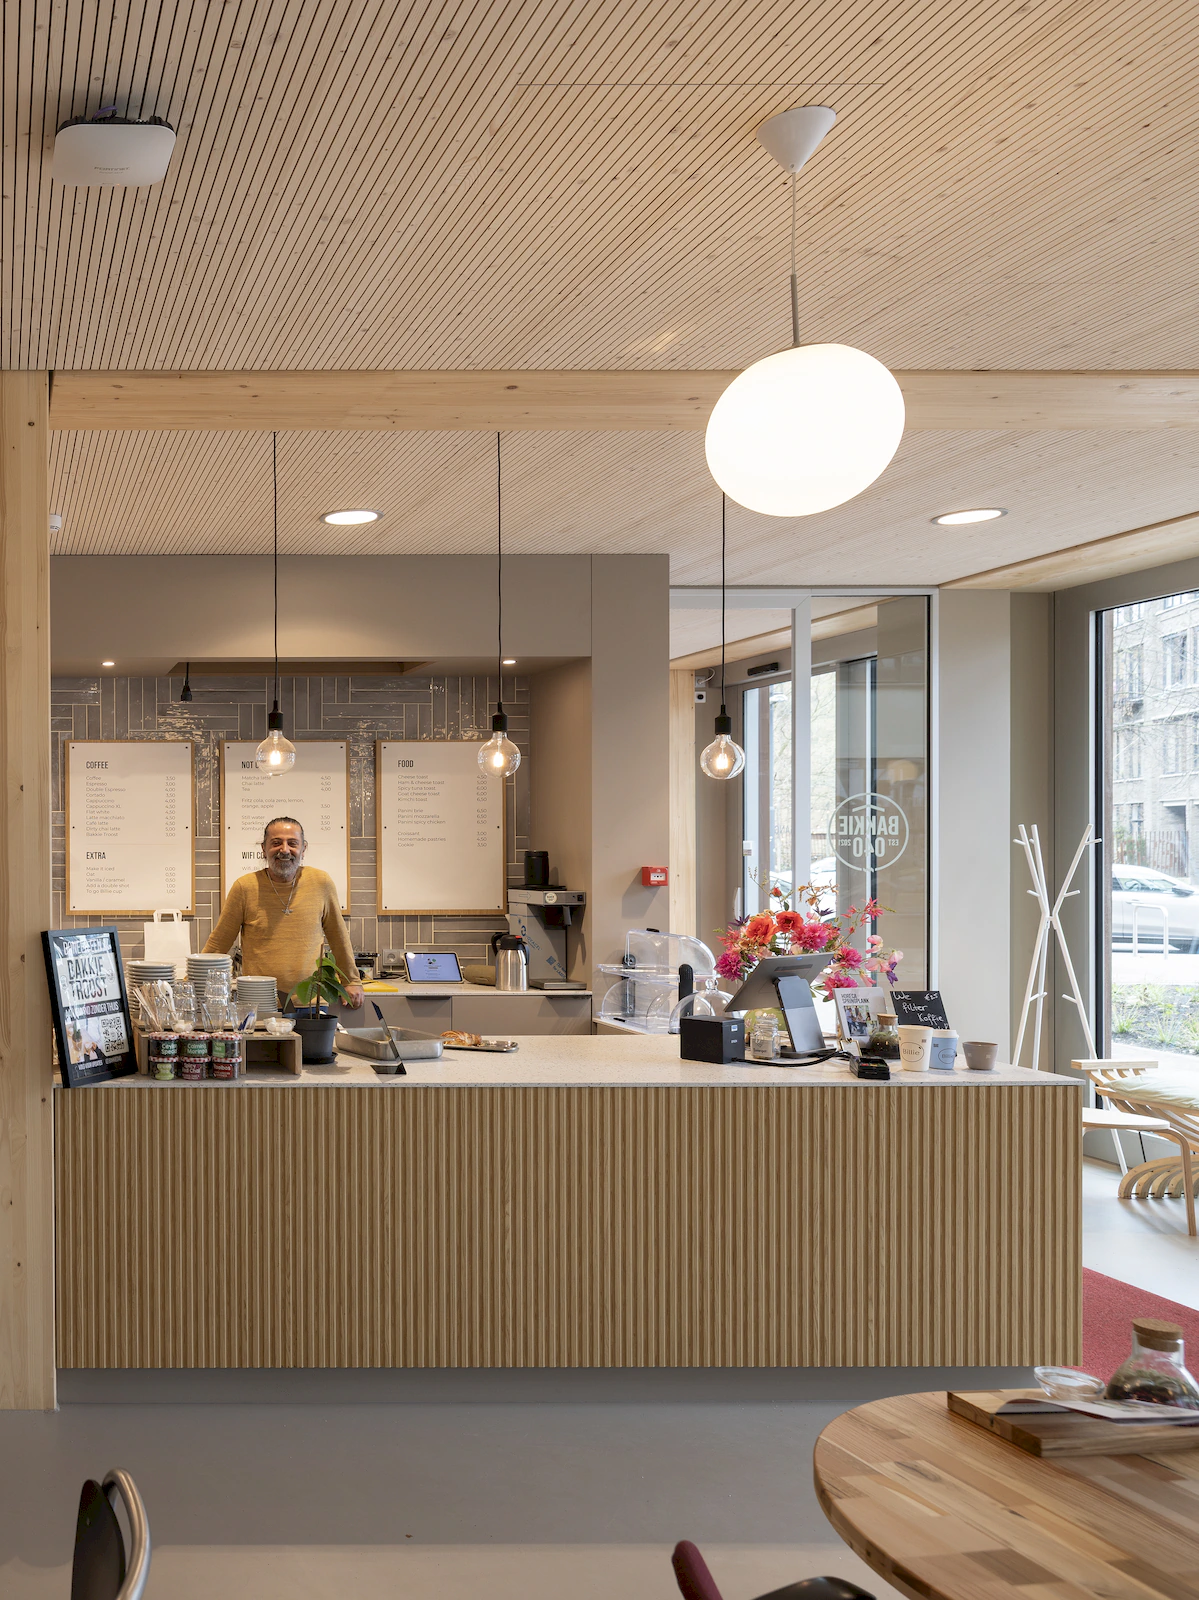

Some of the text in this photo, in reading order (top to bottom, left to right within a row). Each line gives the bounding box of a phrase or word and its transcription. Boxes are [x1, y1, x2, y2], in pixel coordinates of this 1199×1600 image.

[86, 761, 109, 769] COFFEE
[241, 761, 254, 769] NOT
[398, 760, 414, 768] FOOD
[241, 851, 255, 859] WIFI
[67, 956, 104, 980] BAKKIE
[69, 977, 108, 1001] TROOST
[902, 1002, 928, 1013] filter
